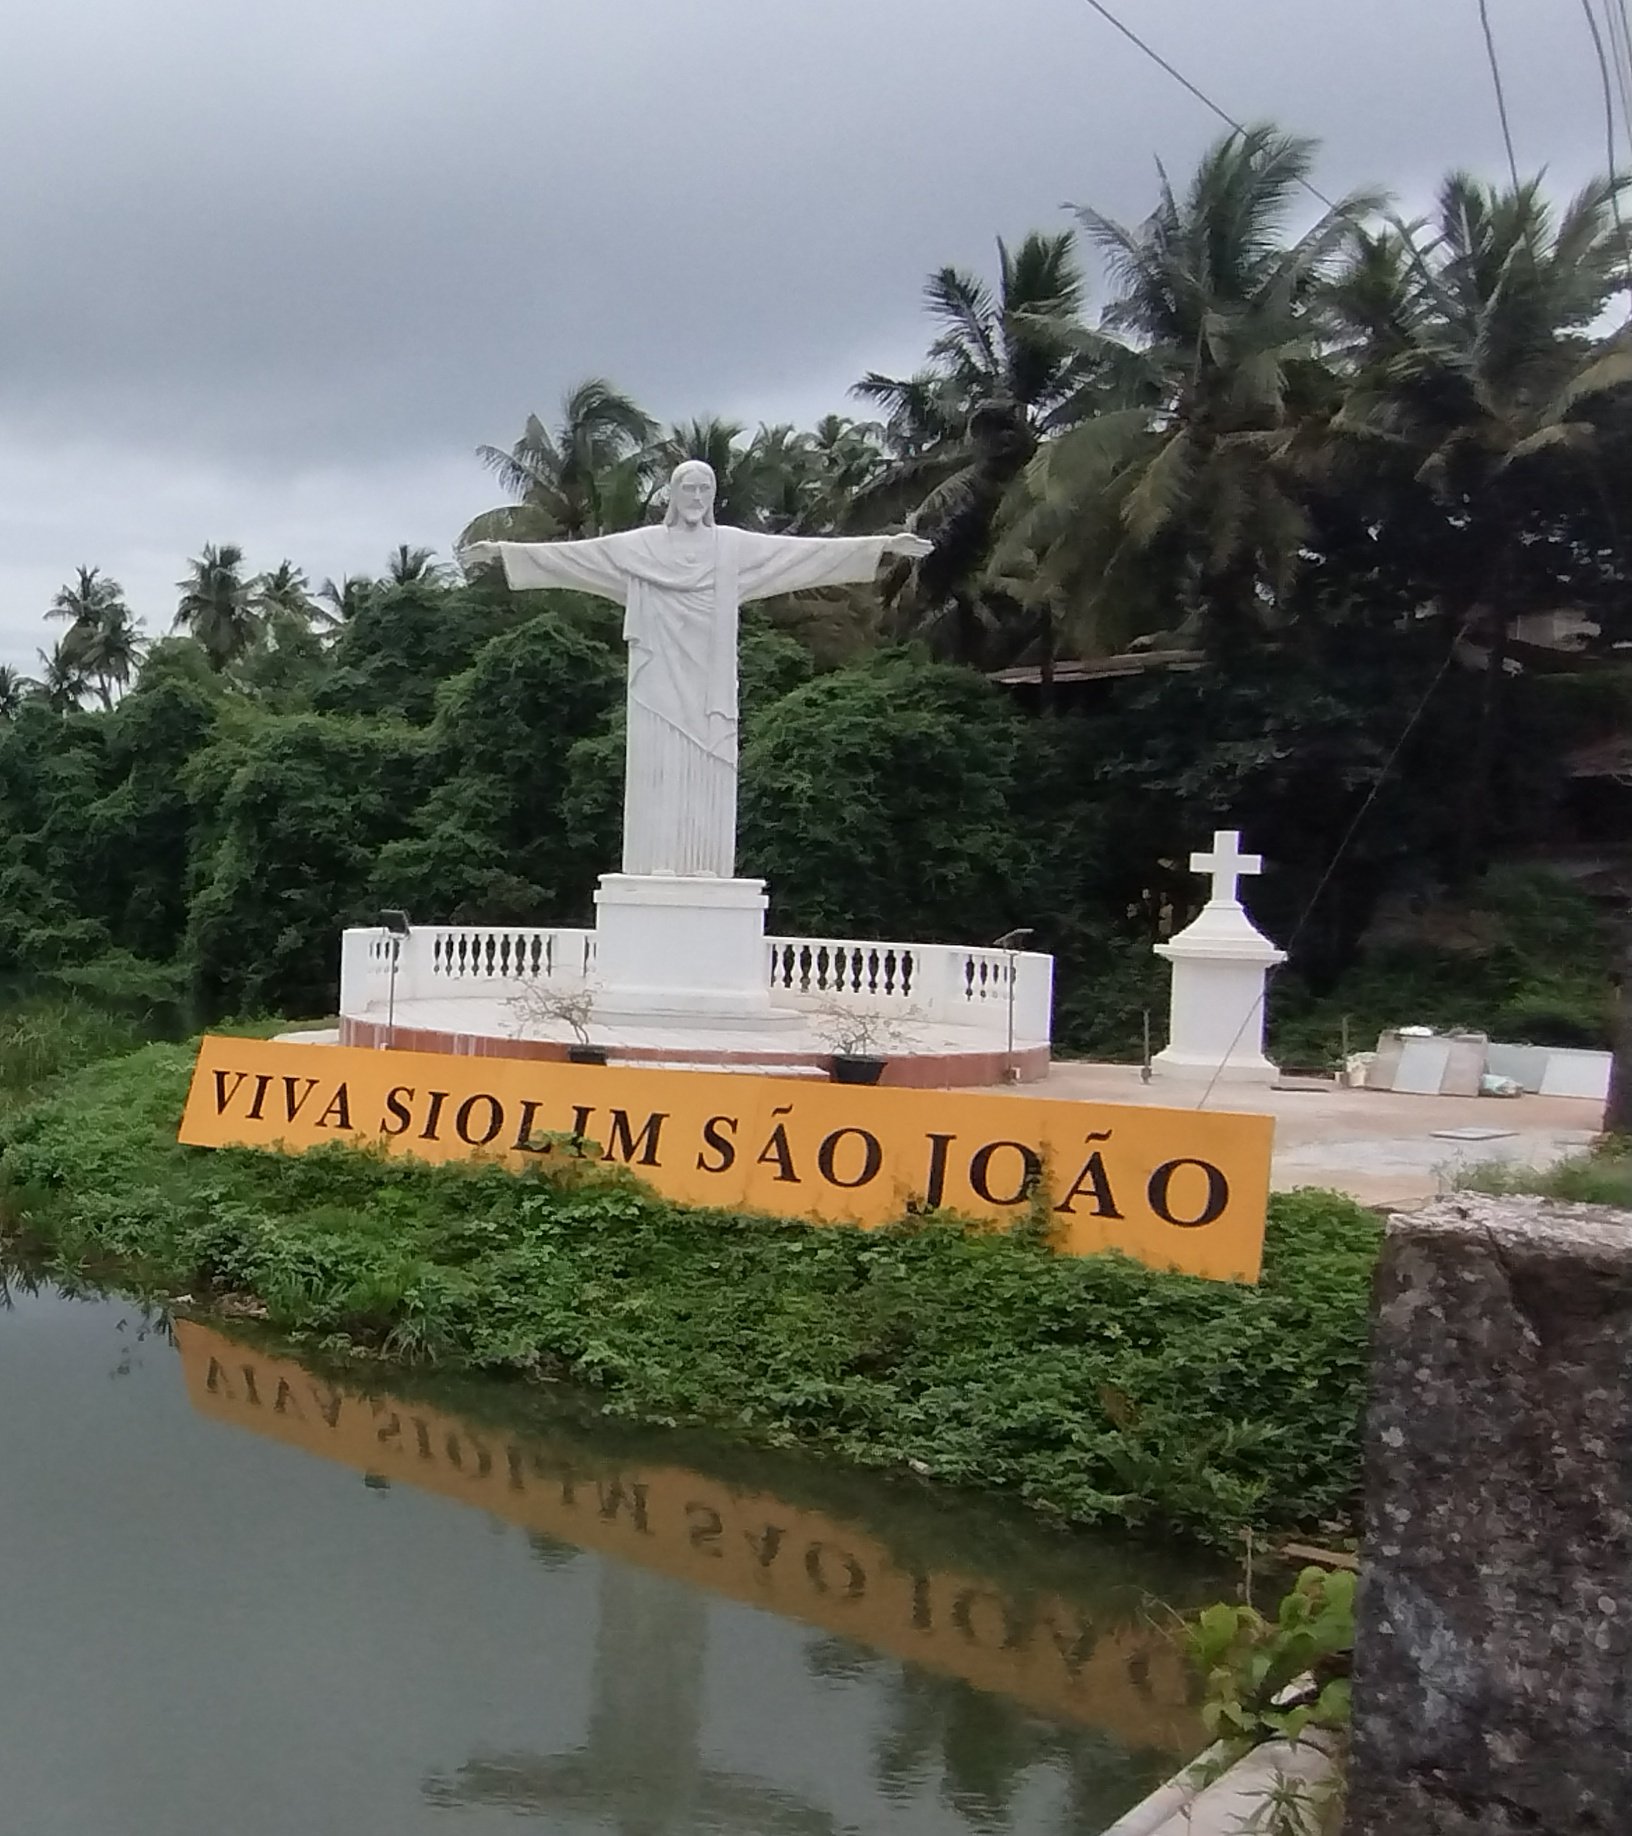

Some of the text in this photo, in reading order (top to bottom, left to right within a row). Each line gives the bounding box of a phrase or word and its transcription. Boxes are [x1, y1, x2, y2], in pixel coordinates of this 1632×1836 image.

[212, 1071, 1229, 1228] VIVA SIOLIM SÃO JOÃO
